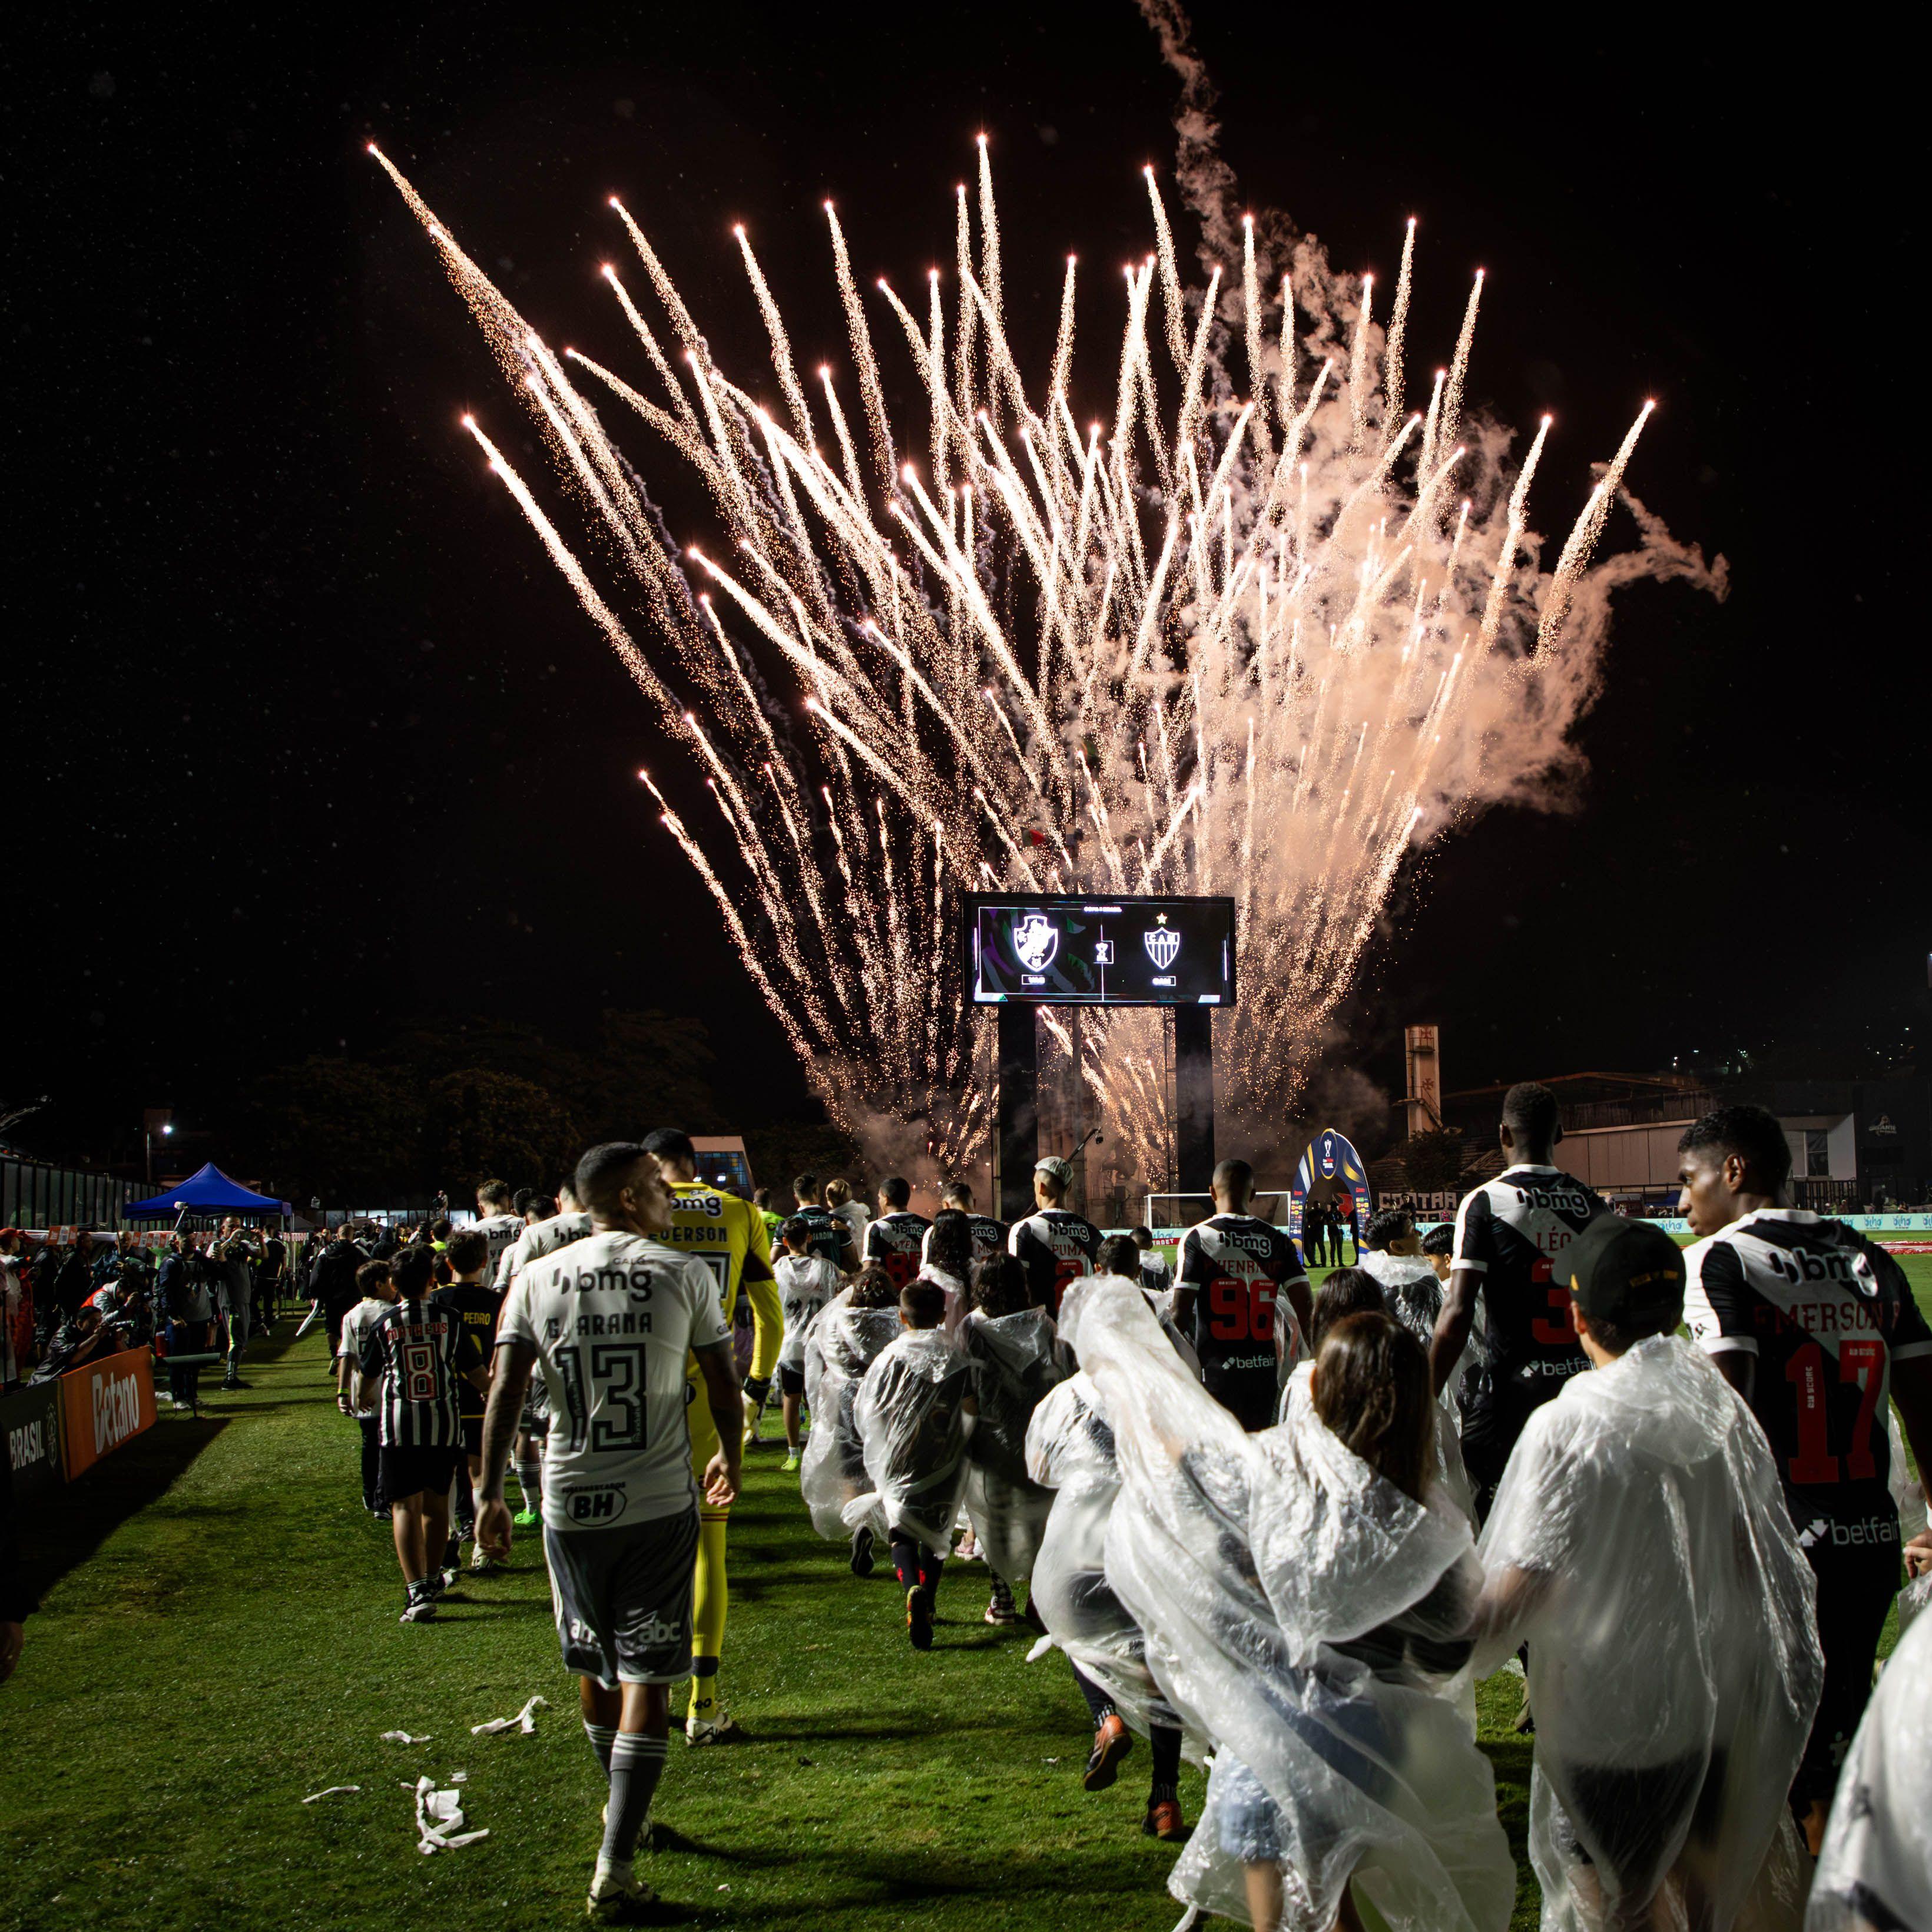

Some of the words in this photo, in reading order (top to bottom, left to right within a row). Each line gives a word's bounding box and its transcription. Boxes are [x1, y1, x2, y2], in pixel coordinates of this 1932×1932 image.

[1533, 1190, 1588, 1216] bmg
[901, 1224, 923, 1238] bmg
[1061, 1223, 1088, 1241] bmg
[1052, 1244, 1085, 1255] PUMA
[1231, 1232, 1270, 1257] bmg
[578, 1266, 651, 1302] bmg
[1801, 1249, 1876, 1295] bmg
[1209, 1278, 1277, 1341] 96
[1532, 1258, 1578, 1345] 3
[463, 1311, 492, 1325] PEDRO
[578, 1313, 652, 1336] ARANA
[386, 1322, 448, 1341] MATHEUS
[403, 1341, 440, 1401] 8
[555, 1343, 647, 1452] 13
[92, 1371, 140, 1454] Betano
[1785, 1340, 1885, 1483] 17
[9, 1420, 45, 1471] BRASIL
[574, 1493, 614, 1519] BH
[638, 1619, 681, 1643] abc
